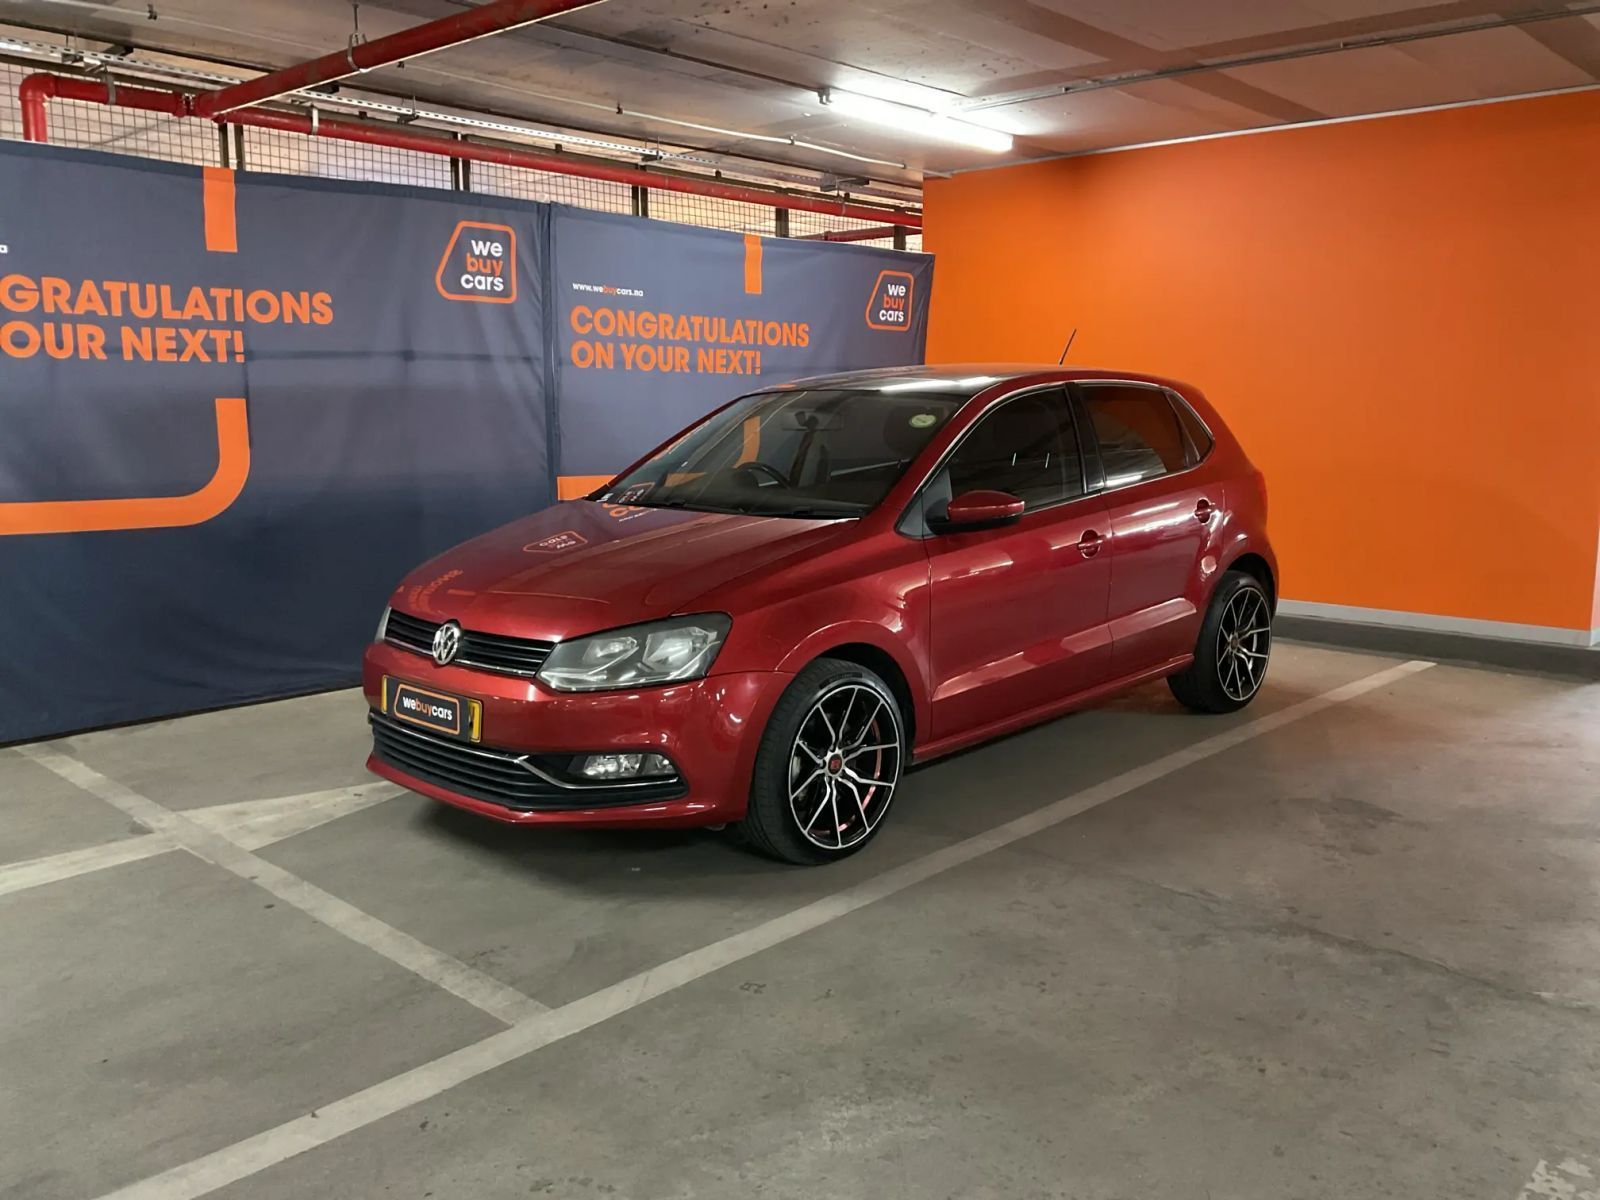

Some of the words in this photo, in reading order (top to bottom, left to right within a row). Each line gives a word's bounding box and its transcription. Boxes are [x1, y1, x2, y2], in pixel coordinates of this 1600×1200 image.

[471, 239, 503, 257] we
[466, 253, 503, 276] buy
[460, 273, 504, 291] cars
[572, 283, 644, 297] www.webuycars.na
[887, 284, 906, 297] we
[883, 294, 905, 311] buy
[879, 309, 904, 322] cars
[570, 305, 809, 347] CONGRATULATIONS
[121, 326, 245, 363] NEXT!
[571, 340, 614, 369] ON
[620, 343, 690, 373] YOUR
[697, 347, 761, 375] NEXT!
[402, 696, 453, 721] webuycars
